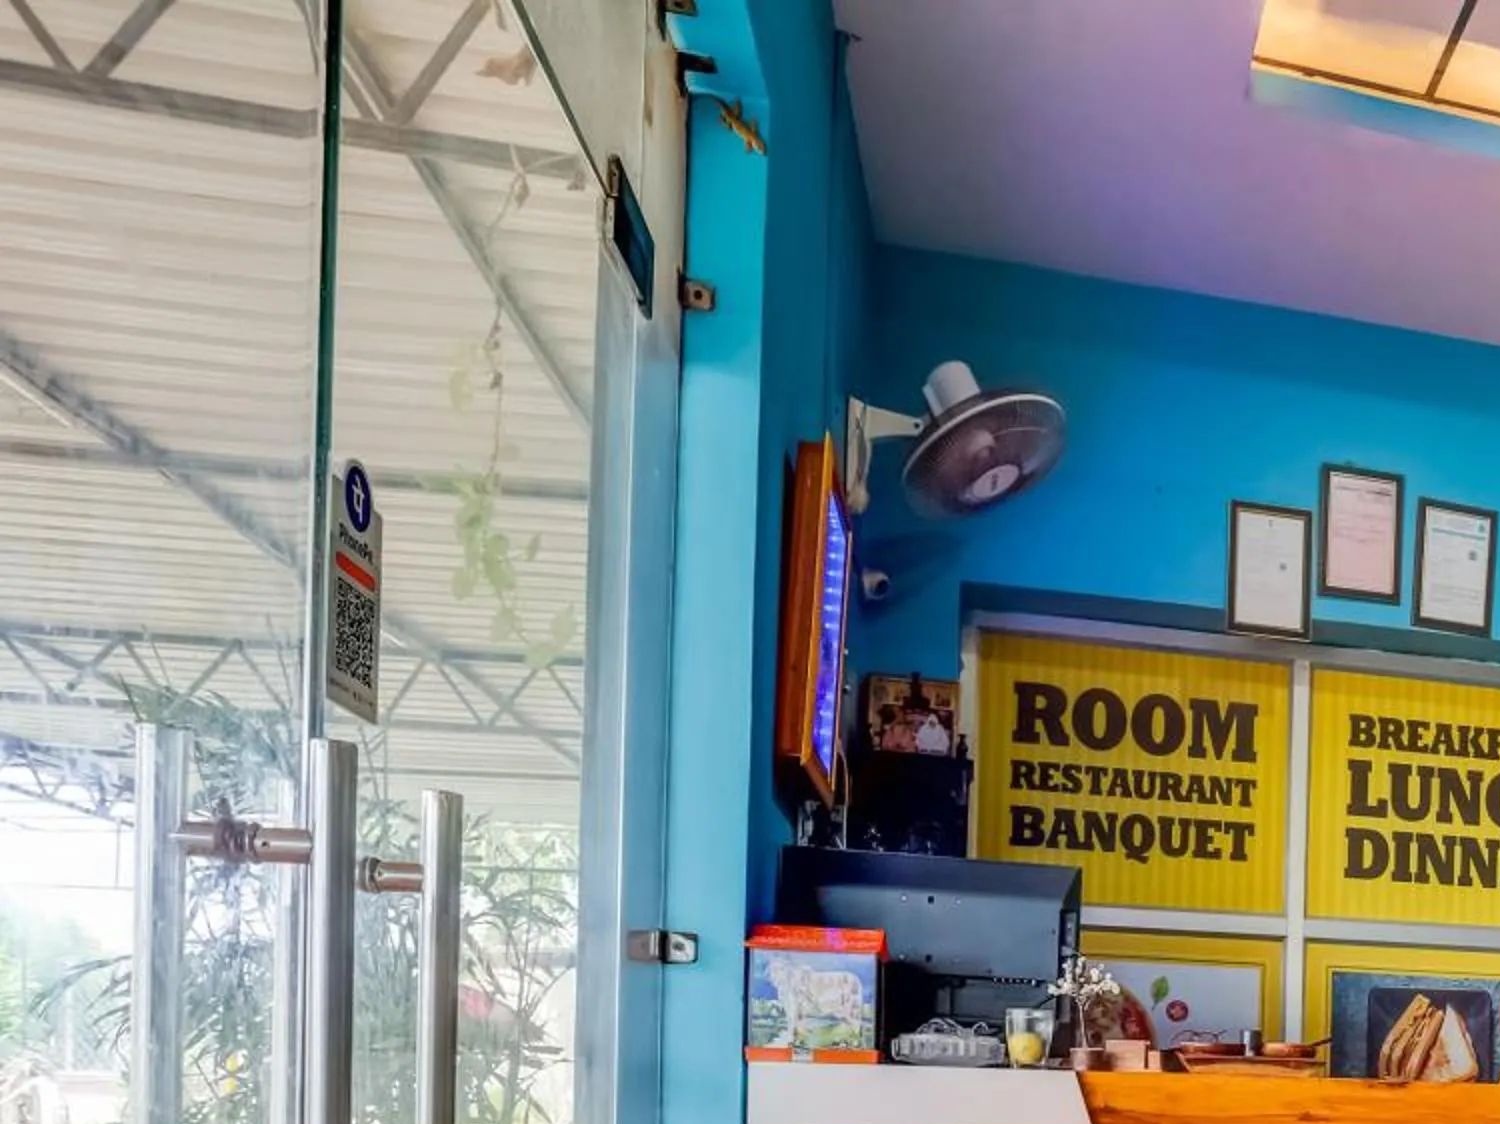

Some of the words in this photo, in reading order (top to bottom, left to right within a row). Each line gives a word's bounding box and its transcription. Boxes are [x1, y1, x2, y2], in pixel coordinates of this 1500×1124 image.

[1011, 682, 1258, 763] ROOM
[1010, 759, 1257, 807] RESTAURANT
[1009, 805, 1255, 864] BANQUET
